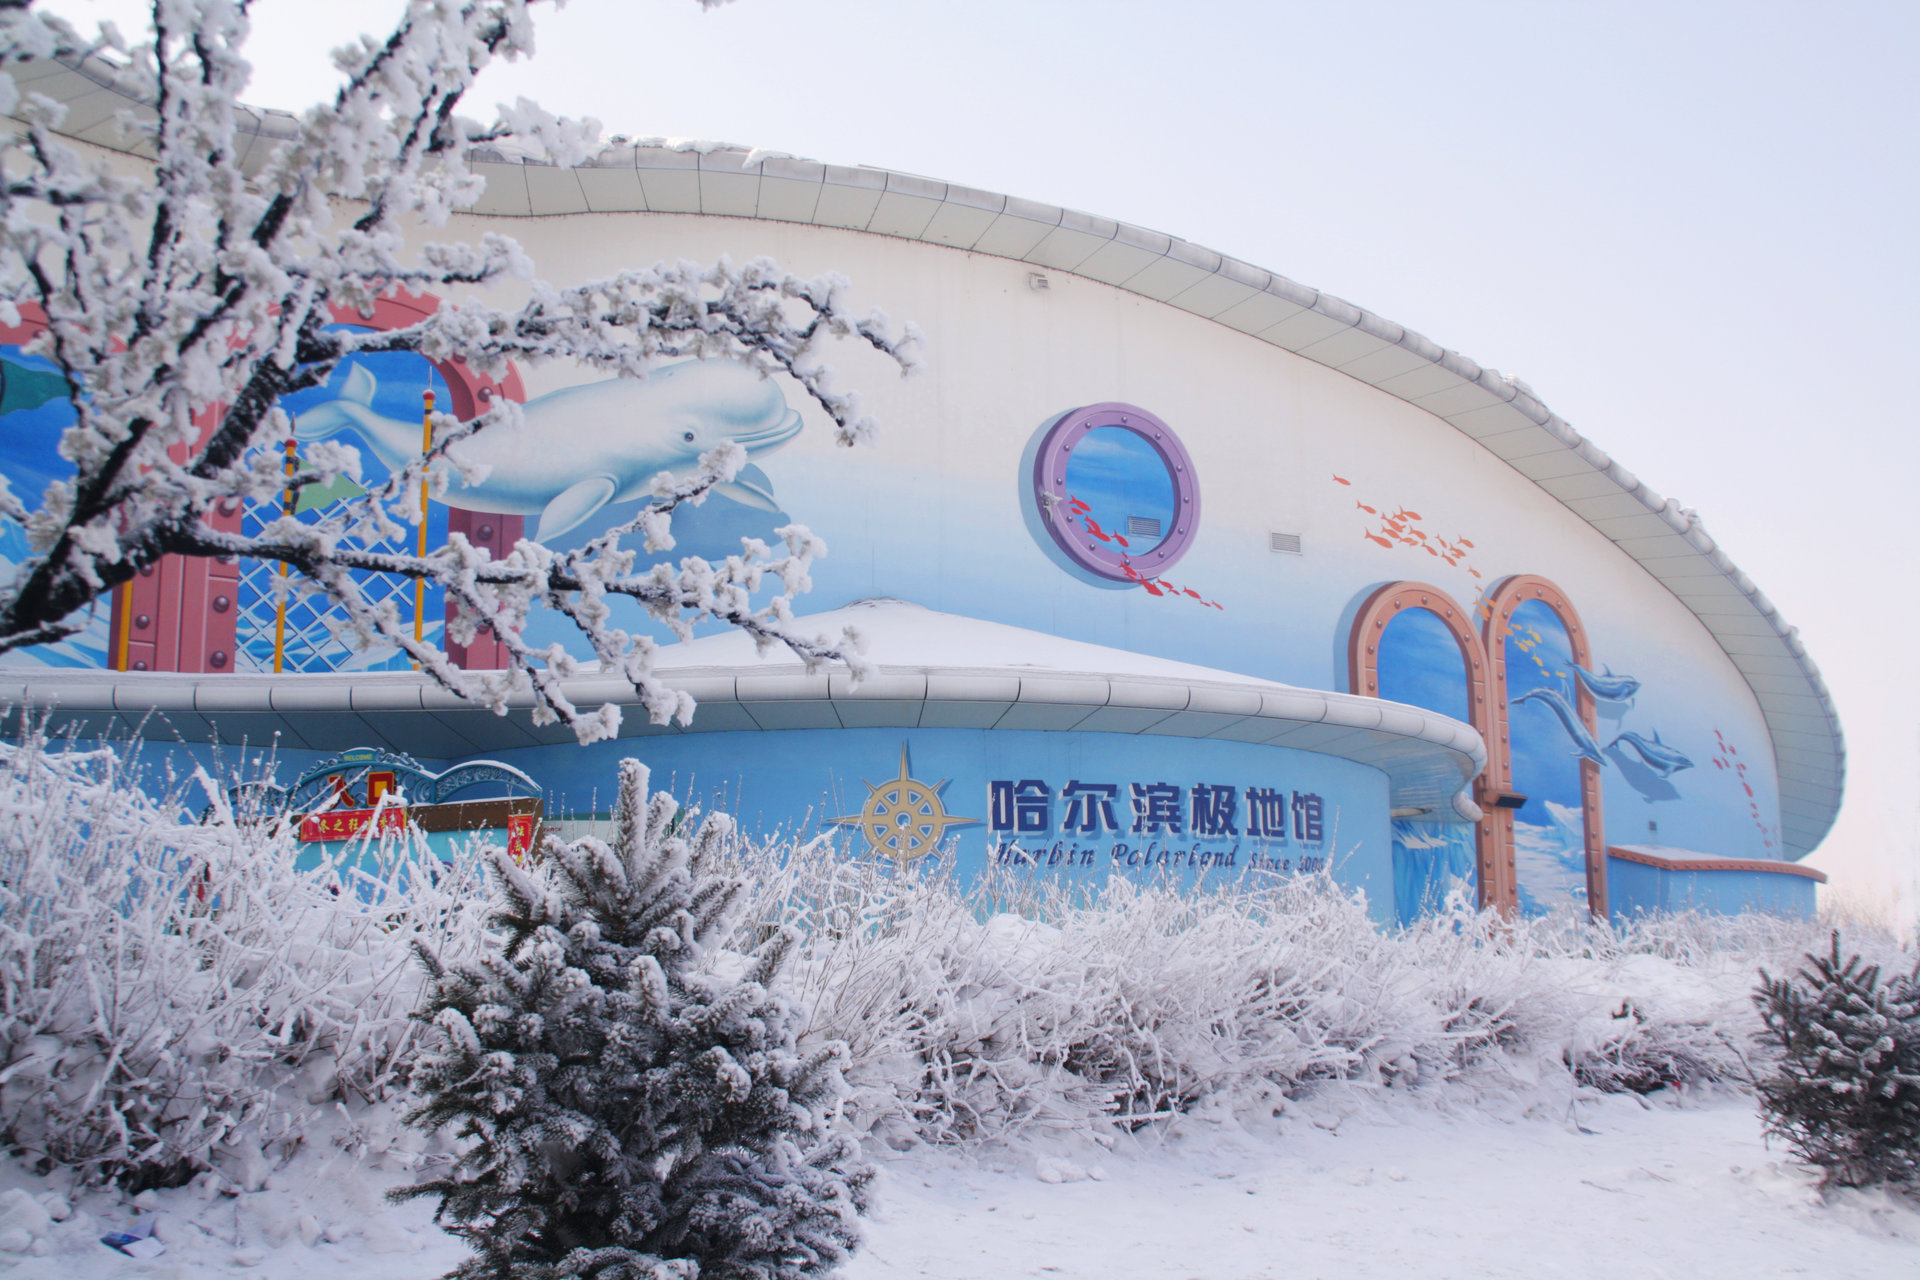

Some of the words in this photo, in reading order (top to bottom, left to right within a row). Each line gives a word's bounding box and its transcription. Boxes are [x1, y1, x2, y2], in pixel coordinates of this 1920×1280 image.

[327, 771, 395, 808] 入口
[988, 779, 1325, 841] 哈尔滨极地馆
[997, 839, 1095, 866] Harbin
[1110, 841, 1239, 867] Polarland
